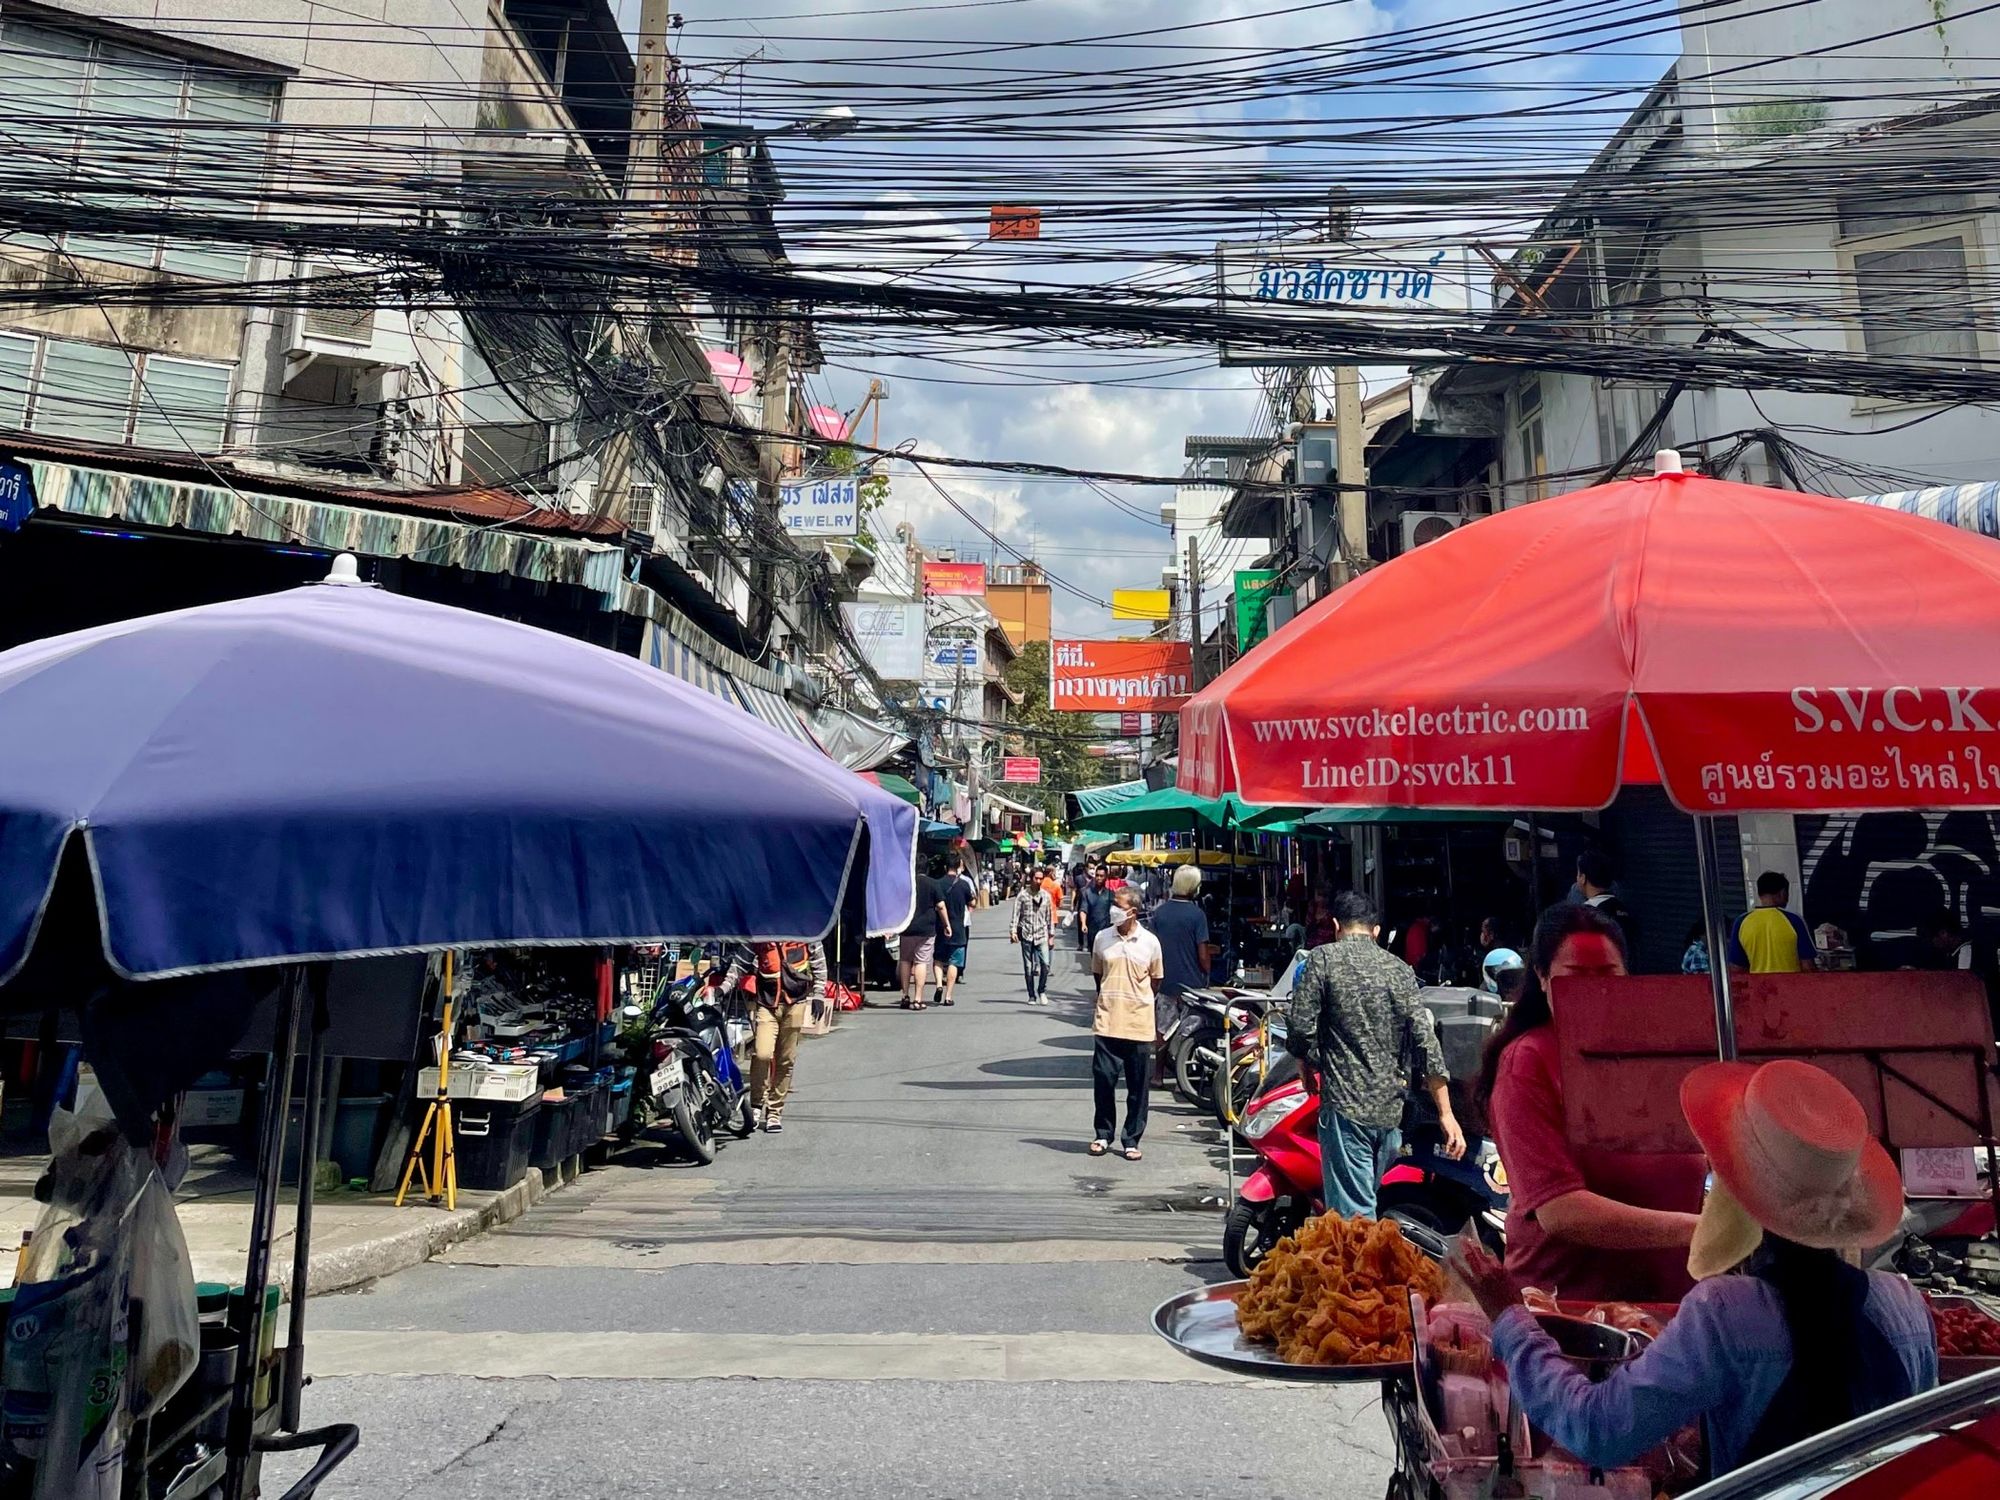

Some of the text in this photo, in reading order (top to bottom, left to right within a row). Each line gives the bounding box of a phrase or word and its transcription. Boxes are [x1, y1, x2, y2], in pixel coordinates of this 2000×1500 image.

[1257, 250, 1446, 301] มิวสิคซาวด์
[786, 515, 853, 527] JEWELRY
[1252, 702, 1590, 743] www.svckelectric.com
[1790, 685, 2000, 733] S.V.C.K
[1301, 754, 1517, 789] LineID:svck11
